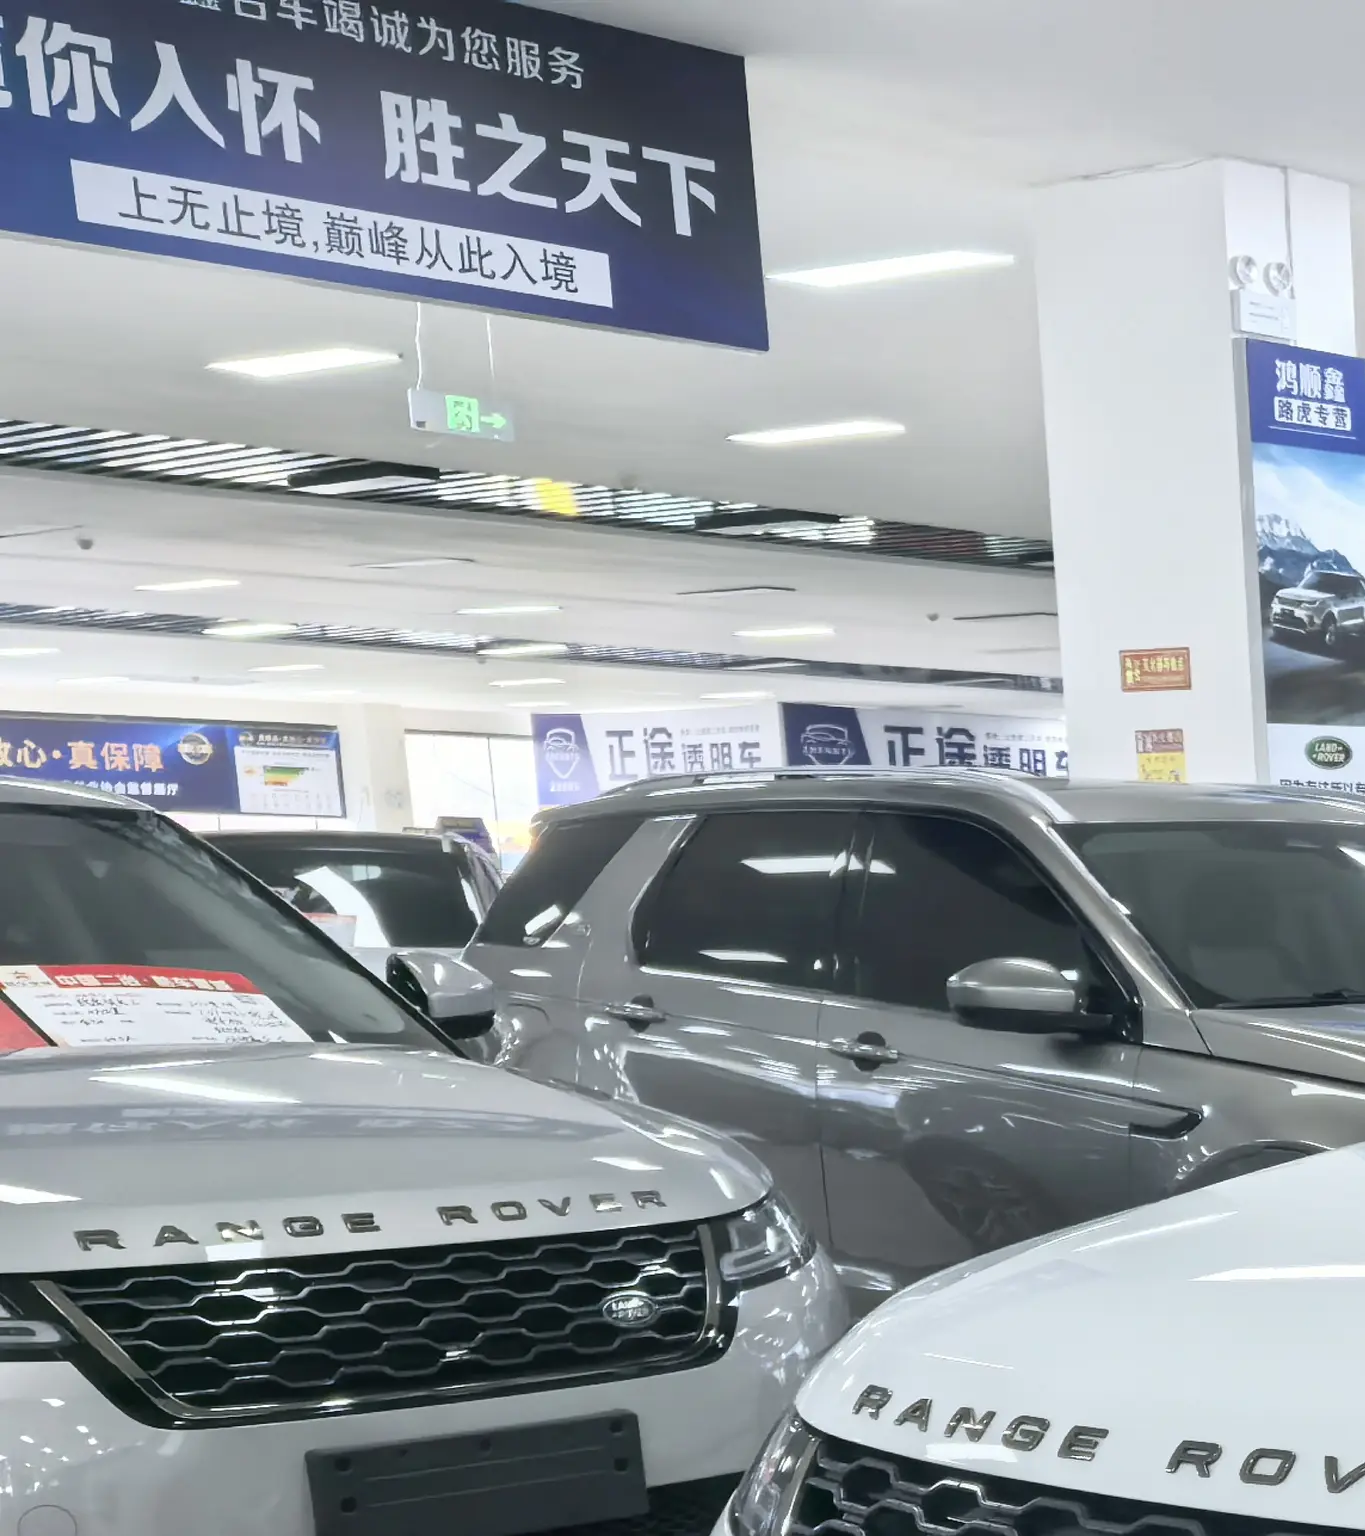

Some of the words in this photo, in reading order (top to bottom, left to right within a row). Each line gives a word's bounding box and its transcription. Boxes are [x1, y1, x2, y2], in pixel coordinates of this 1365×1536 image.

[0, 15, 321, 164] 你入怀
[380, 90, 717, 238] 胜之天下
[1275, 358, 1346, 403] 鸿顺鑫
[1277, 399, 1349, 429] 路虎专营
[1314, 742, 1338, 753] LAND
[1316, 751, 1345, 763] ROVER
[74, 1212, 381, 1252] RANGE
[437, 1189, 668, 1227] ROVER
[852, 1384, 1109, 1462] RANGE
